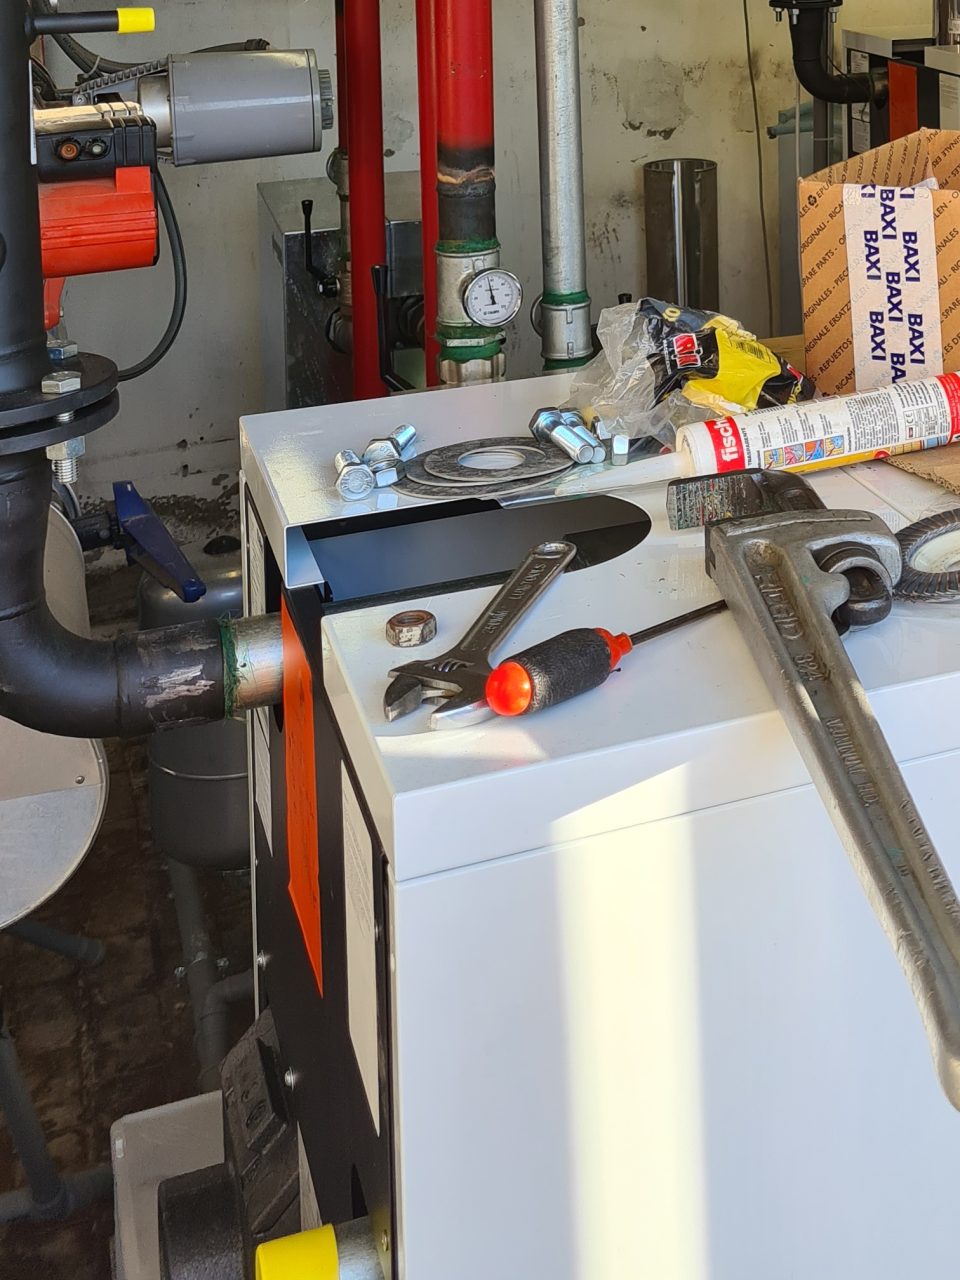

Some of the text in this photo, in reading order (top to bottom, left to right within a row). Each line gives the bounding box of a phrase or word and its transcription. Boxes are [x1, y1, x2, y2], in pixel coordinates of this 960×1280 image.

[880, 189, 897, 240] BAXI
[815, 249, 835, 270] PARTS
[864, 231, 881, 280] BAXI
[902, 232, 920, 282] BAXI
[886, 272, 903, 322] BAXI
[817, 337, 852, 373] REPUESTOS
[869, 311, 886, 361] BAXI
[908, 314, 925, 364] BAXI
[890, 353, 906, 383] BA
[716, 415, 740, 462] fisch
